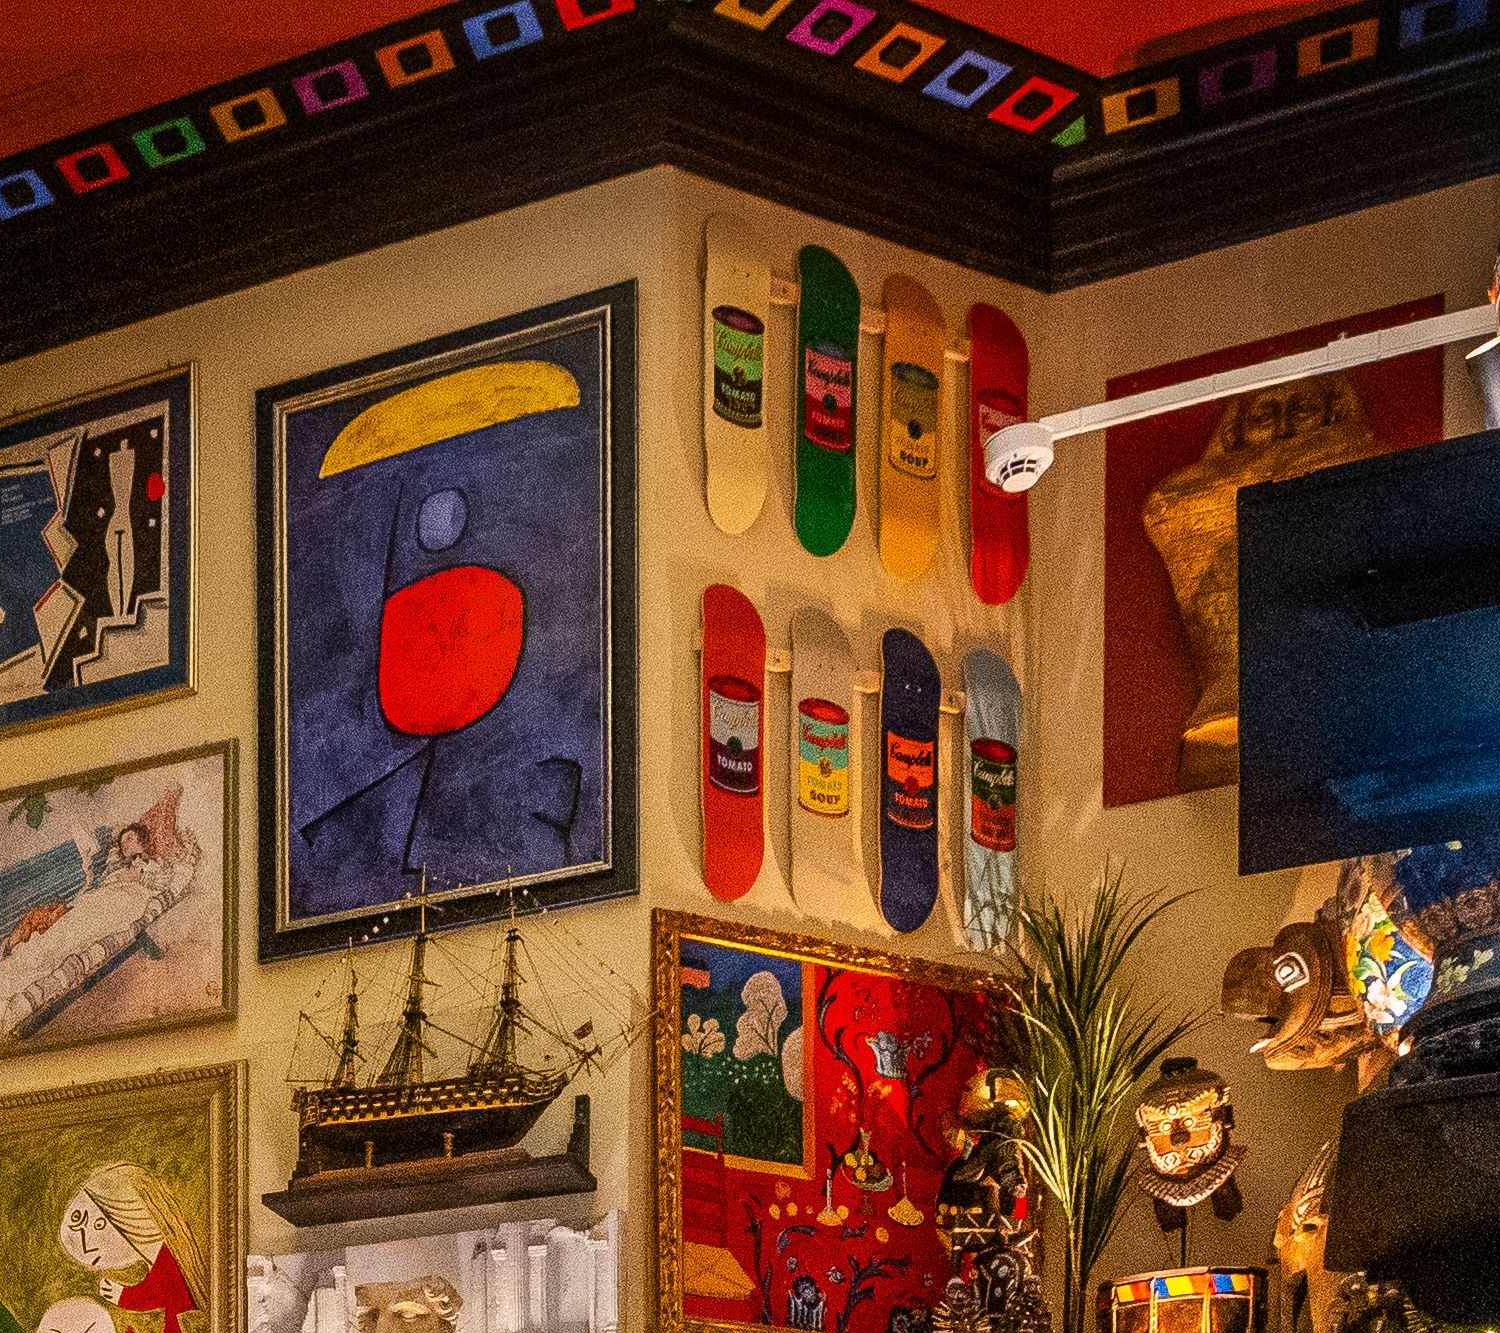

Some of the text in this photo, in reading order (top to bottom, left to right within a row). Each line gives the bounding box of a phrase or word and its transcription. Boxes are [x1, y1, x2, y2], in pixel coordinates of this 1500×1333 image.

[900, 450, 929, 468] SOUP
[716, 753, 753, 773] TOMATO
[809, 789, 840, 805] SOUP
